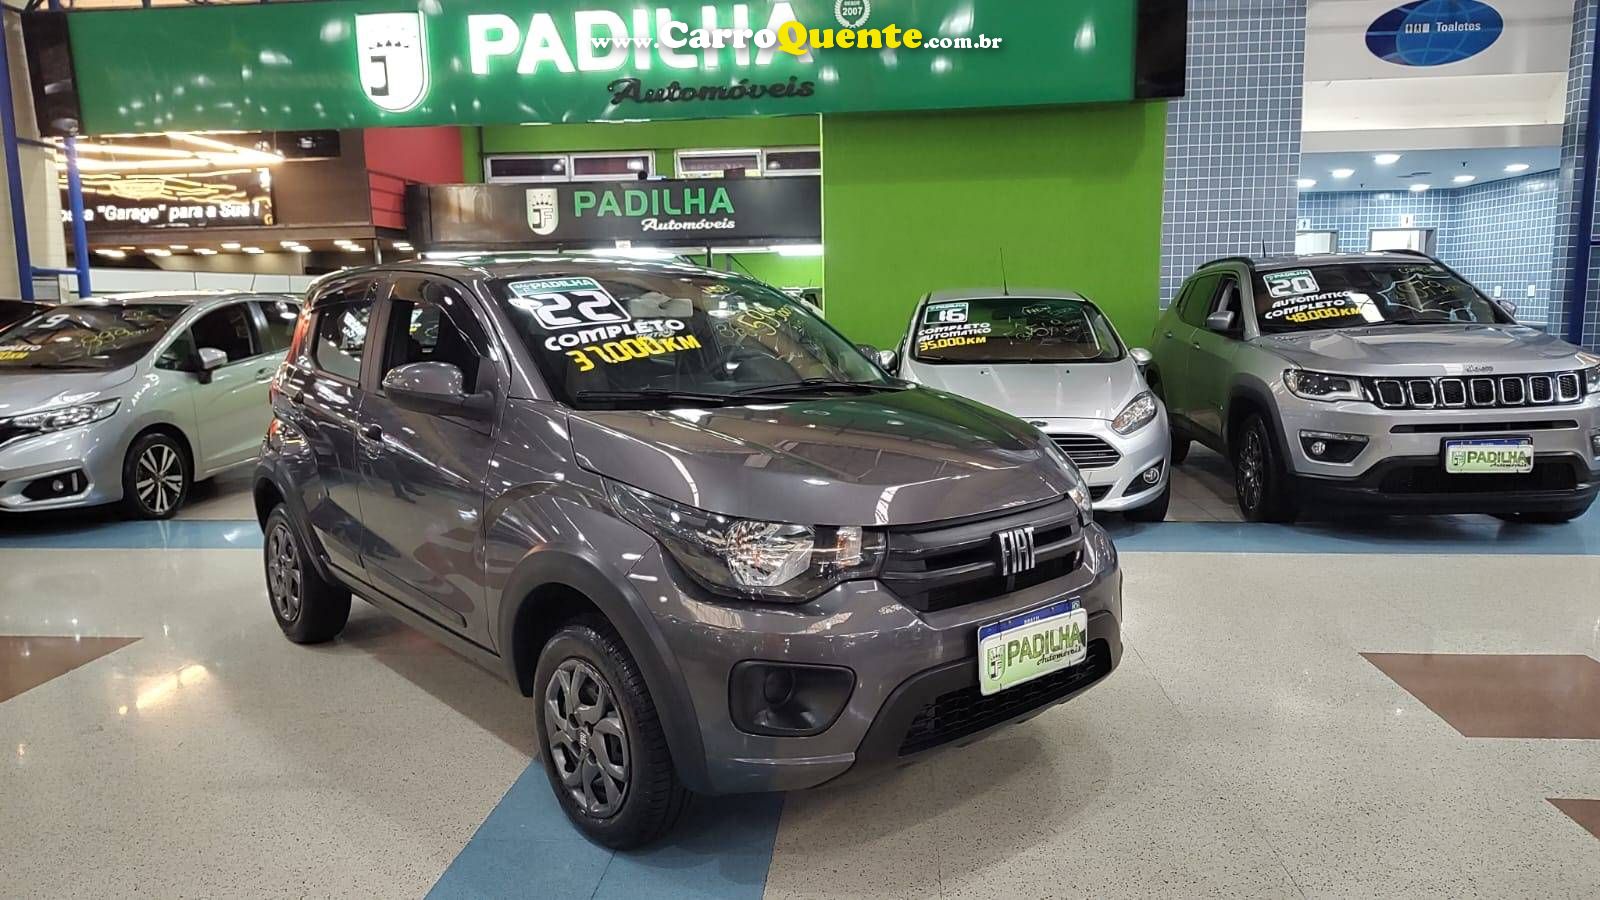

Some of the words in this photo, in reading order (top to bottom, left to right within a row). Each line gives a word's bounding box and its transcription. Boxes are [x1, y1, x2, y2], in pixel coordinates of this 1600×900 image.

[842, 7, 863, 16] 2007
[1436, 22, 1481, 32] Toaletes
[467, 2, 815, 76] PADILHA
[608, 76, 816, 106] Automóveis
[574, 187, 734, 217] PADILHA
[168, 206, 204, 222] para
[206, 206, 217, 218] a
[641, 218, 735, 232] Automóveis
[530, 279, 593, 290] PADILHA
[1271, 277, 1316, 296] 20
[529, 290, 622, 326] 22
[1272, 291, 1351, 309] AUTOMATICO
[939, 308, 966, 322] 16
[1264, 299, 1345, 319] COMPLETO
[22, 314, 70, 329] 19
[918, 322, 991, 336] COMPLETO
[545, 319, 685, 350] COMPLETO
[918, 328, 992, 343] AUTOMATICO
[1467, 451, 1527, 463] PADILHA
[999, 527, 1036, 576] FIAT
[1007, 621, 1081, 667] PADILHA
